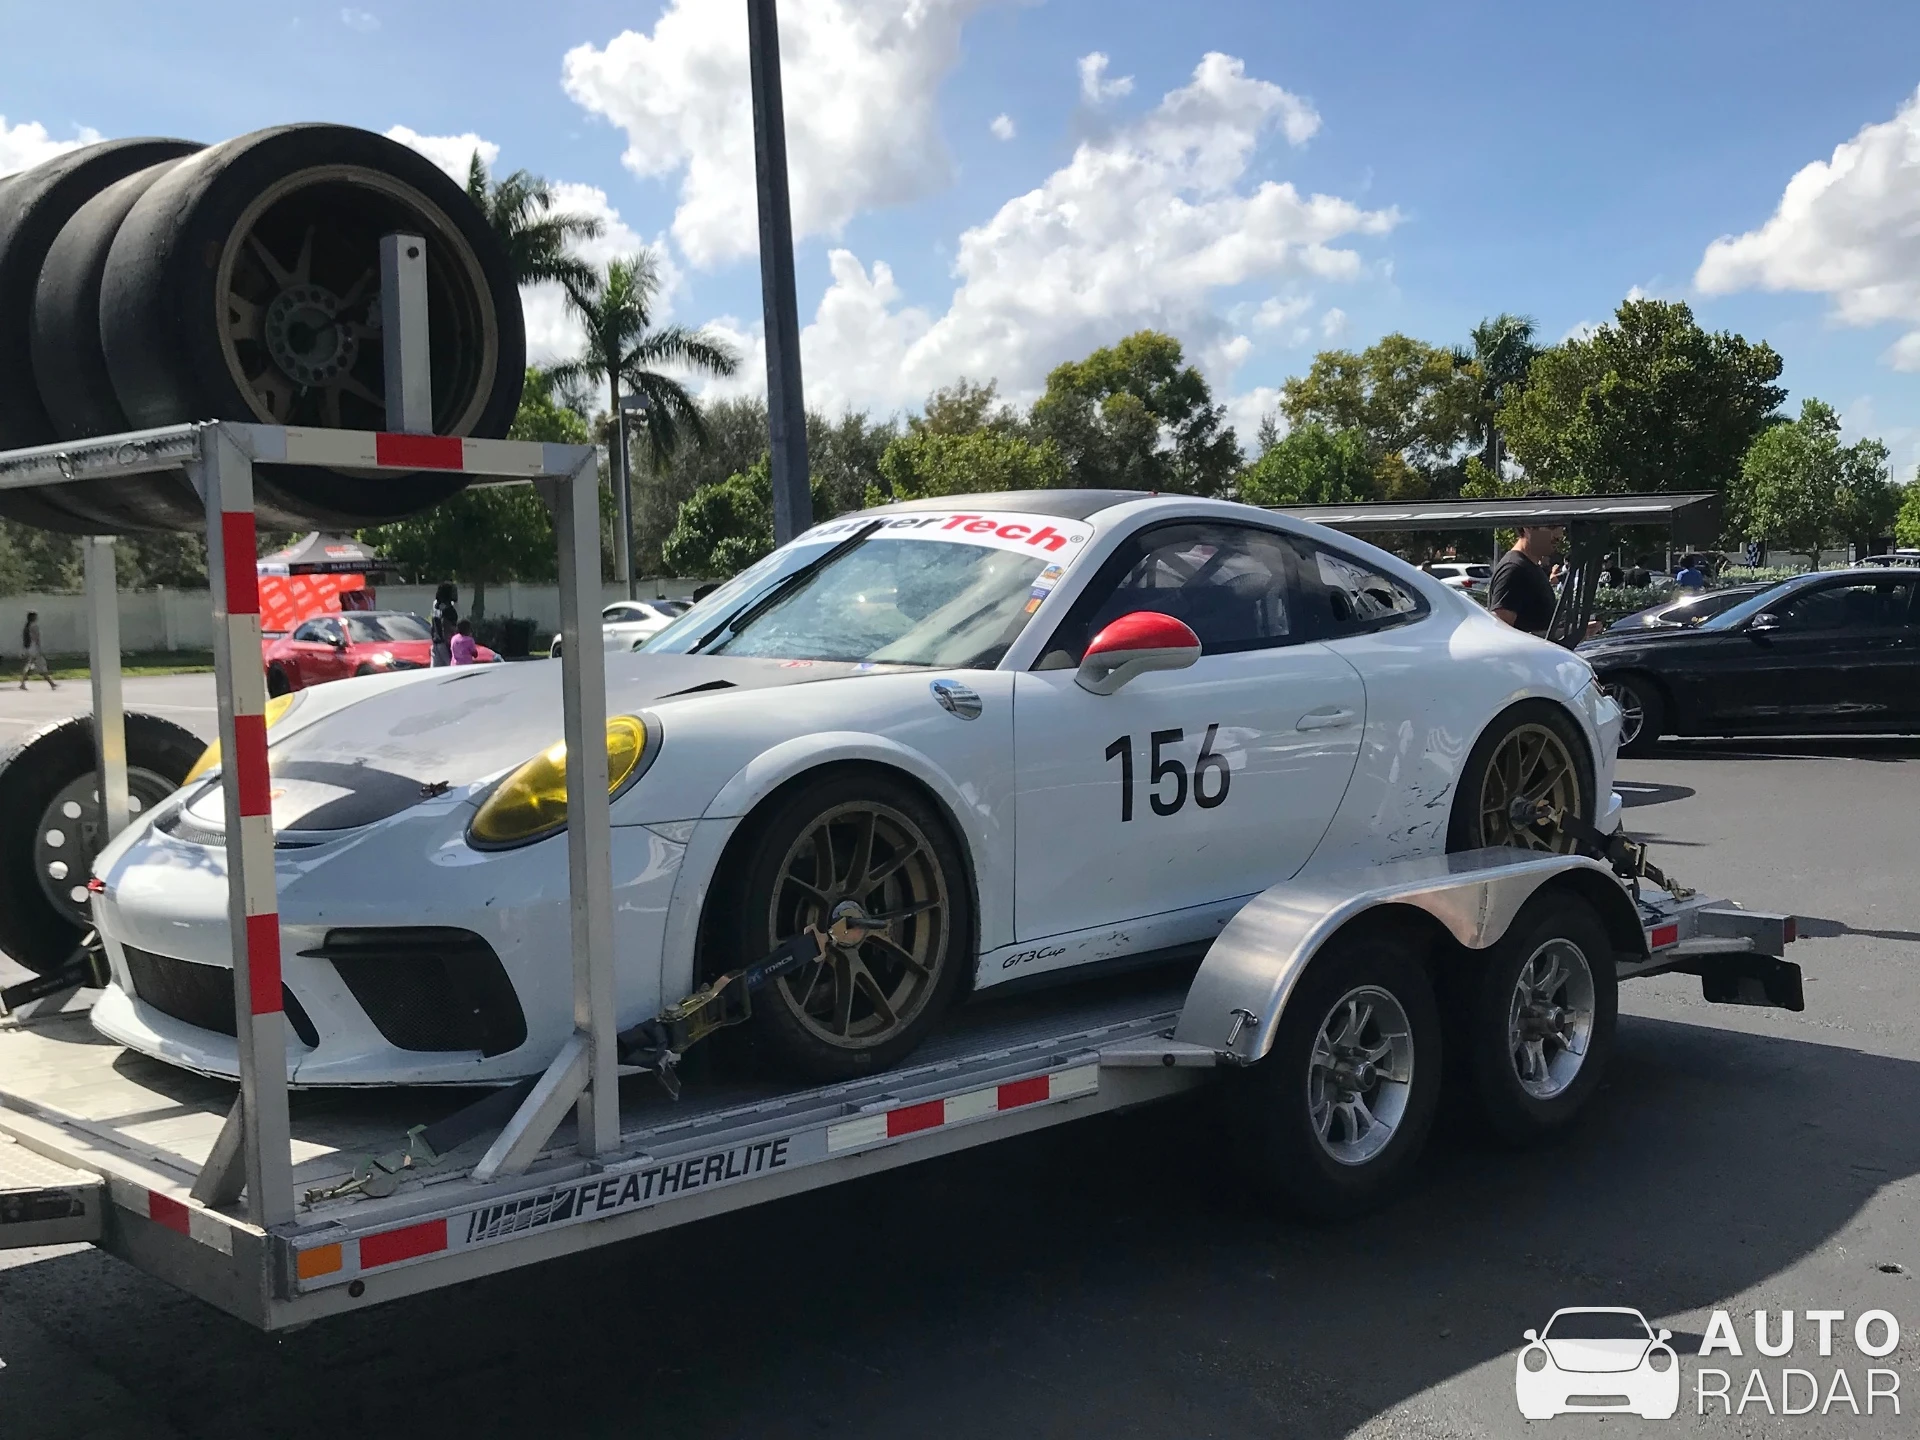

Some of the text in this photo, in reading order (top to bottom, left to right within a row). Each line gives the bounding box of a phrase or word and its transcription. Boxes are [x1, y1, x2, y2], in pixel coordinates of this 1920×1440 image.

[1301, 504, 1672, 523] ORSCHE
[1105, 723, 1231, 822] 156
[575, 1137, 790, 1217] FEATHERLITE
